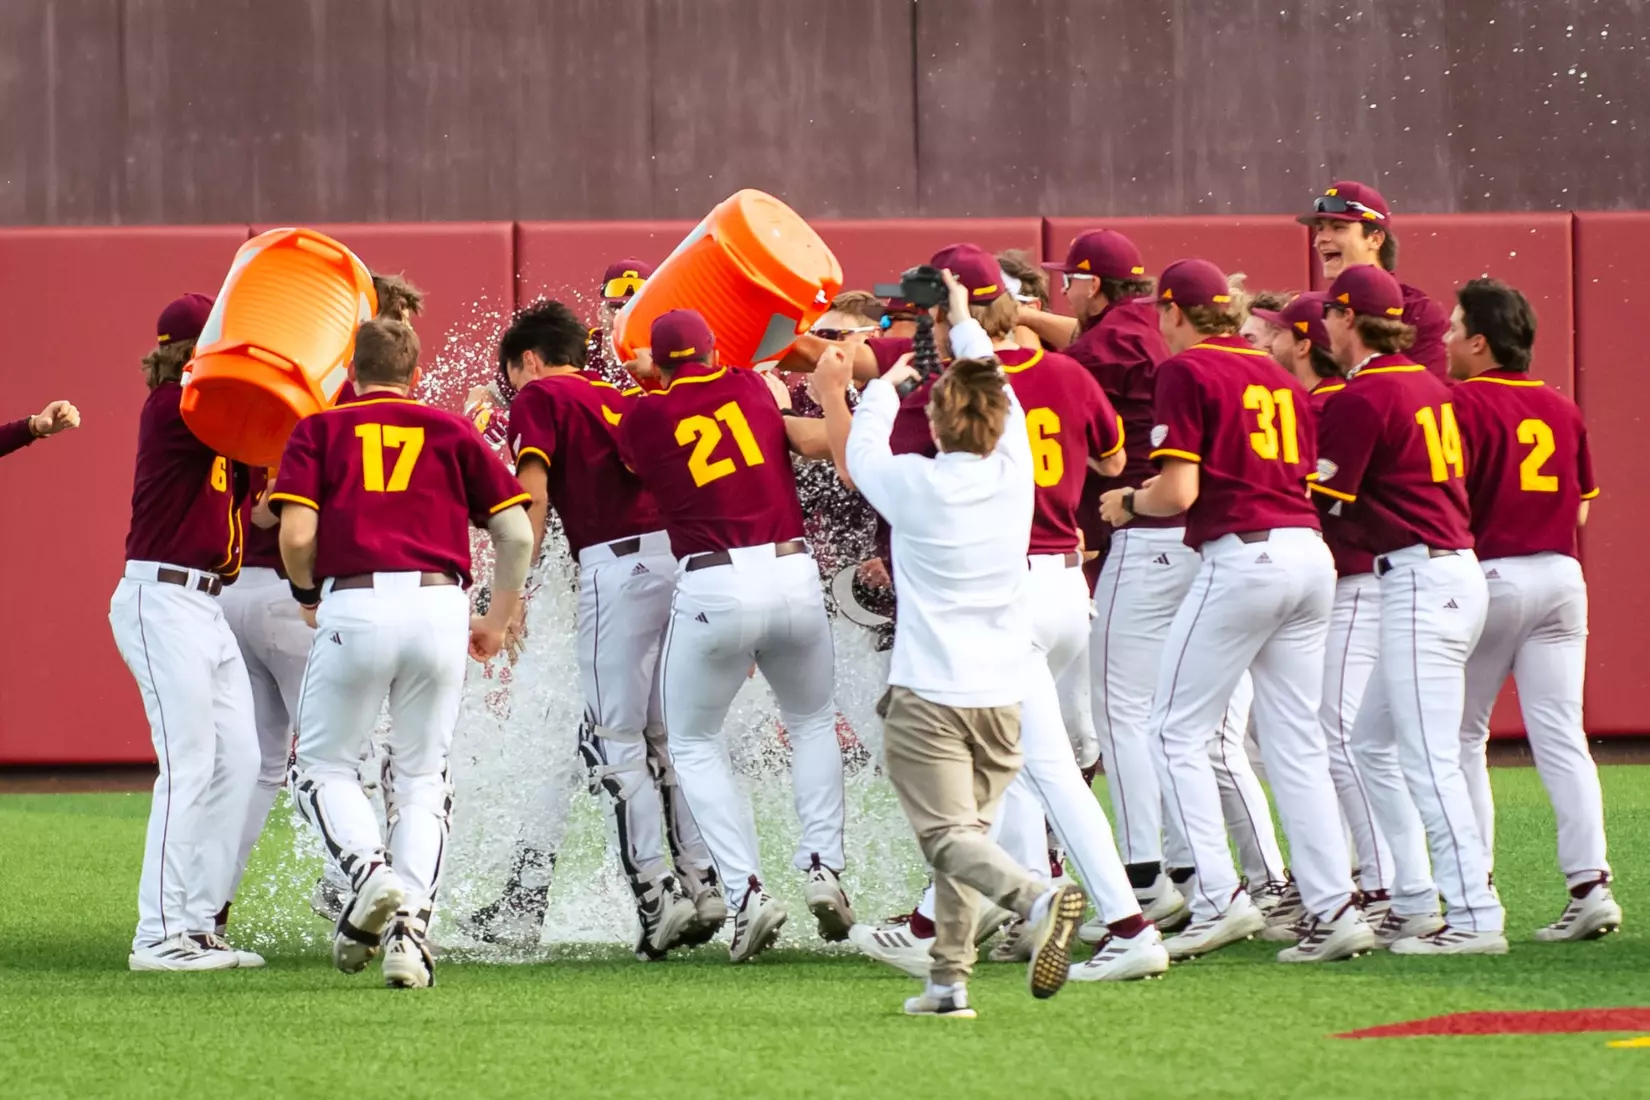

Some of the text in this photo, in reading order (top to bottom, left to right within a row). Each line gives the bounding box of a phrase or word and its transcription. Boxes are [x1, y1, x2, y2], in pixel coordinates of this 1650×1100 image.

[354, 422, 425, 492] 17
[674, 401, 765, 488] 21
[1025, 407, 1064, 488] 6
[1243, 384, 1299, 465] 31
[1415, 402, 1464, 483] 14
[1517, 418, 1560, 492] 2
